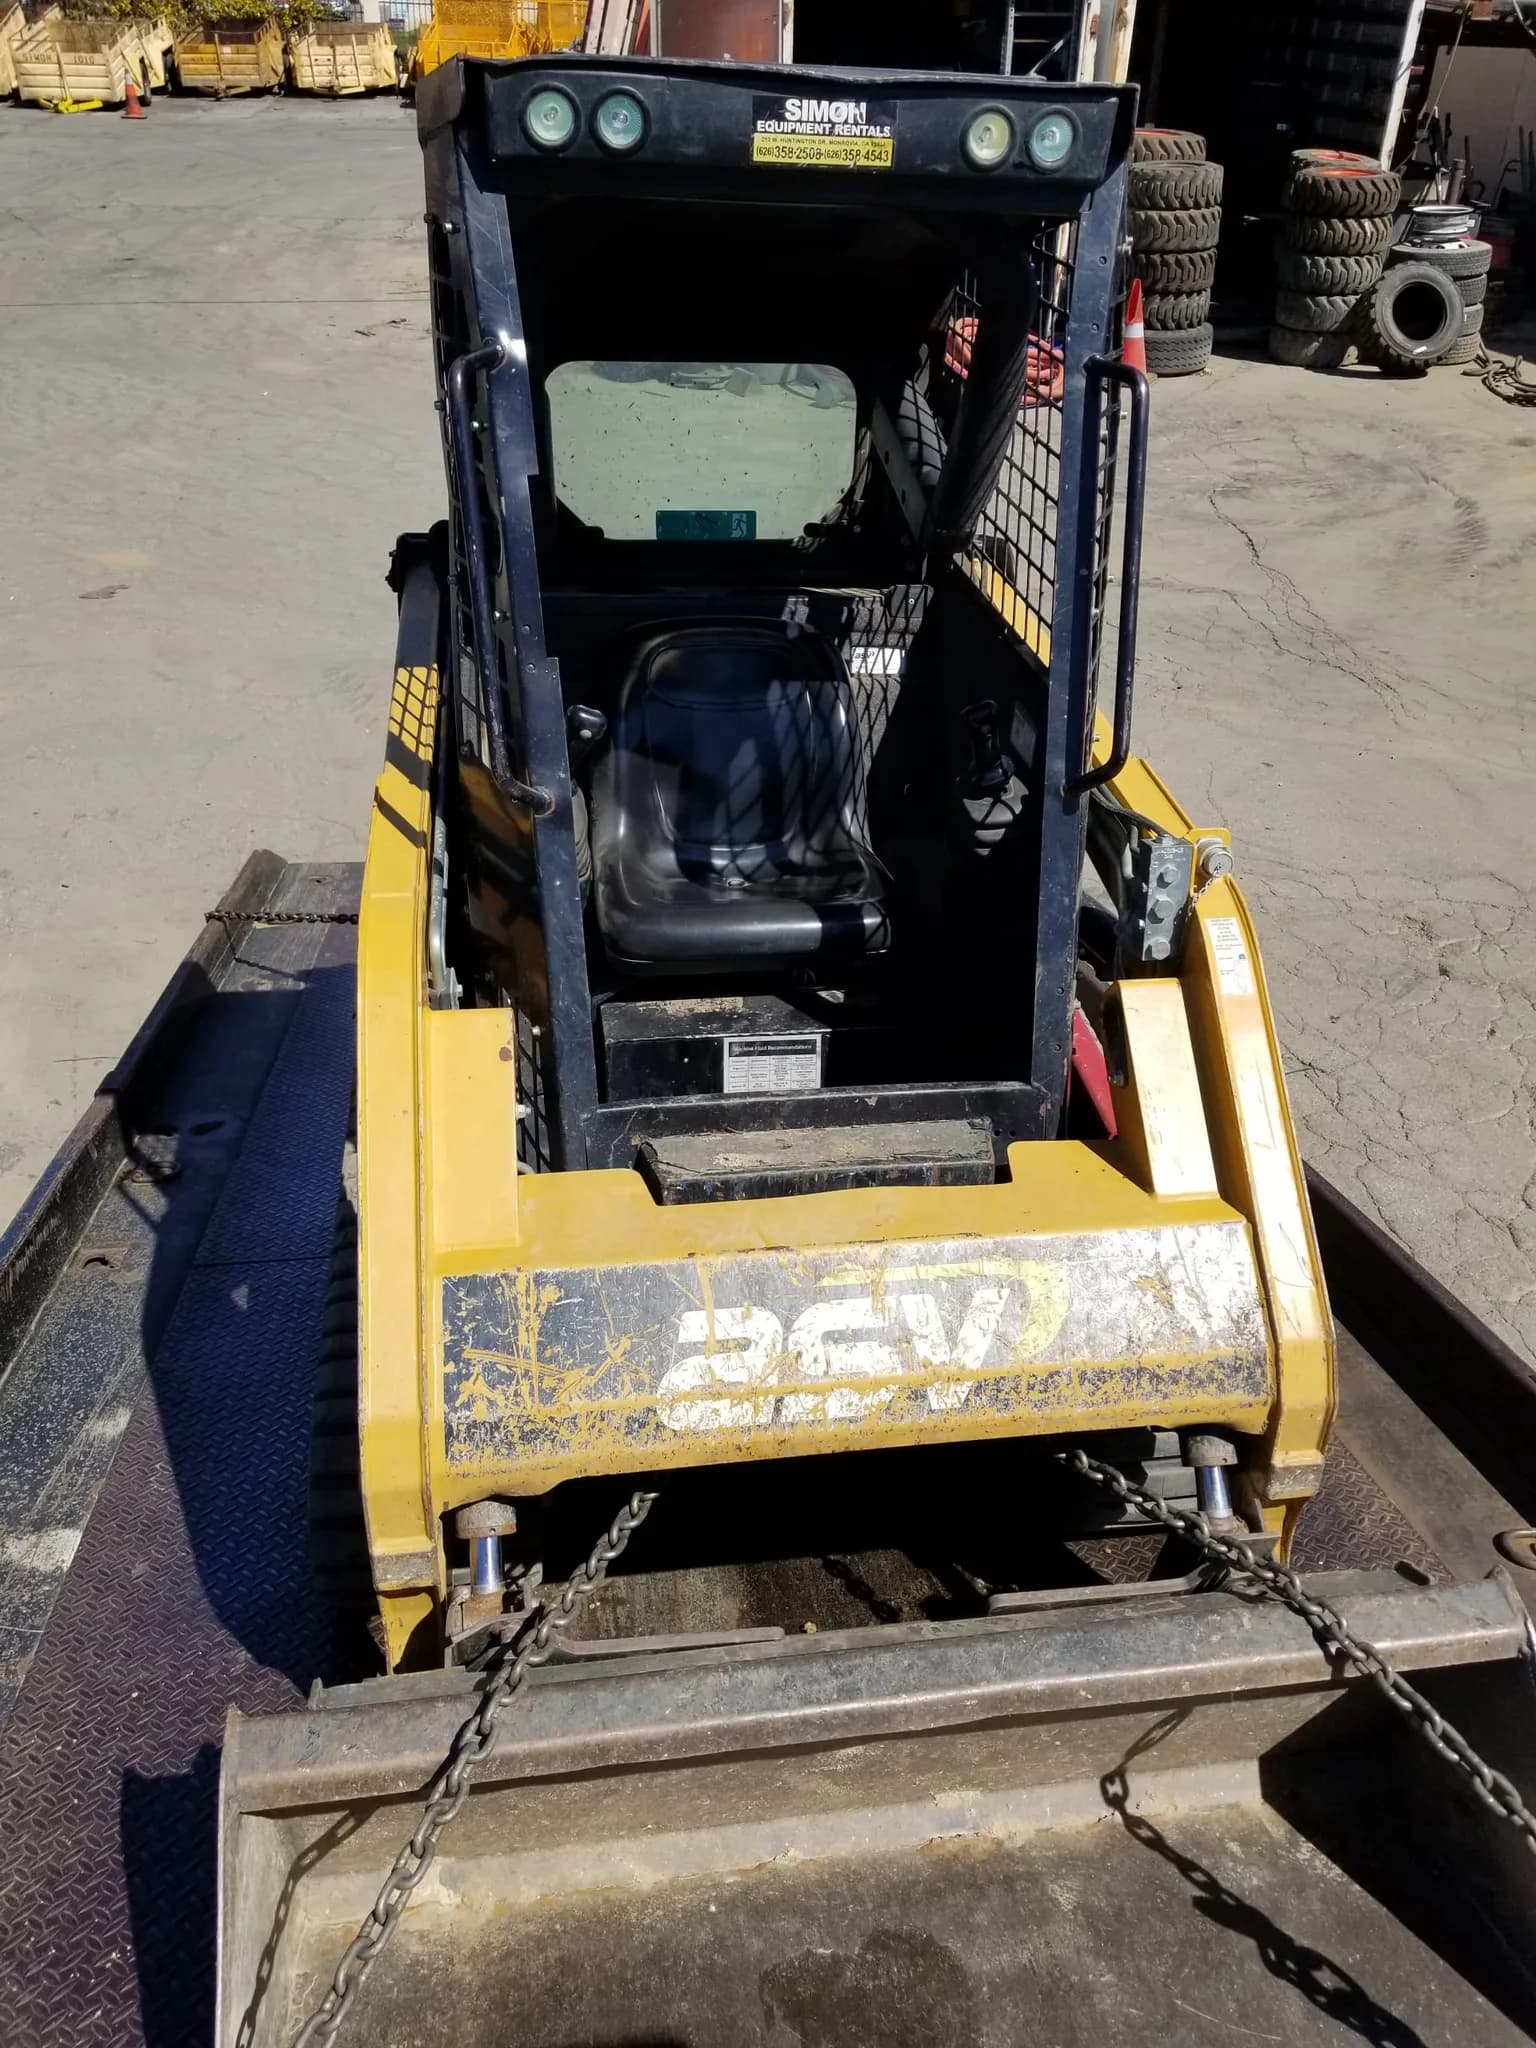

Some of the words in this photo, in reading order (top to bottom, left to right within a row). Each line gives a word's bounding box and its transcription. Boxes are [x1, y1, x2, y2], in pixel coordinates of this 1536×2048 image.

[784, 99, 867, 123] SIMON
[756, 119, 832, 135] EQUIPMENT
[834, 124, 891, 137] RENTALS
